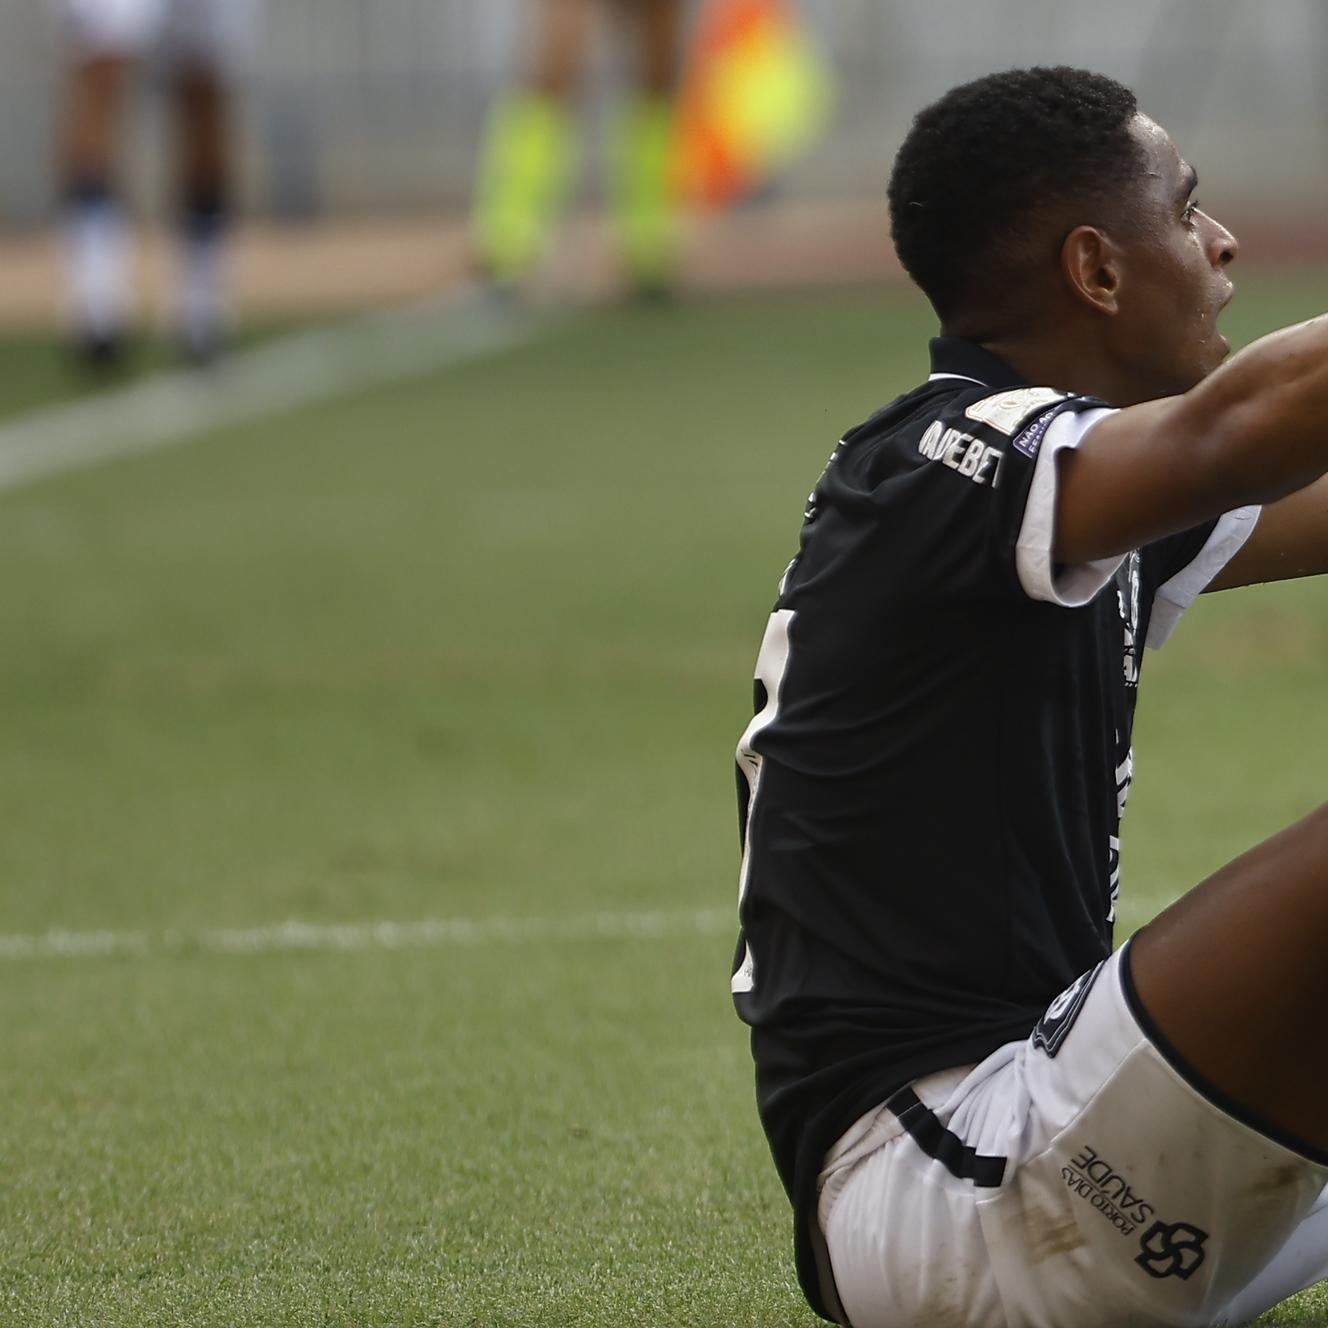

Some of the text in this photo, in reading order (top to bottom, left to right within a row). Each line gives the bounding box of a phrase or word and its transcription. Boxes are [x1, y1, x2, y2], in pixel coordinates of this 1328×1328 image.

[1061, 1167, 1135, 1236] PORTO DIAS
[1070, 1145, 1155, 1224] SAÚDE
